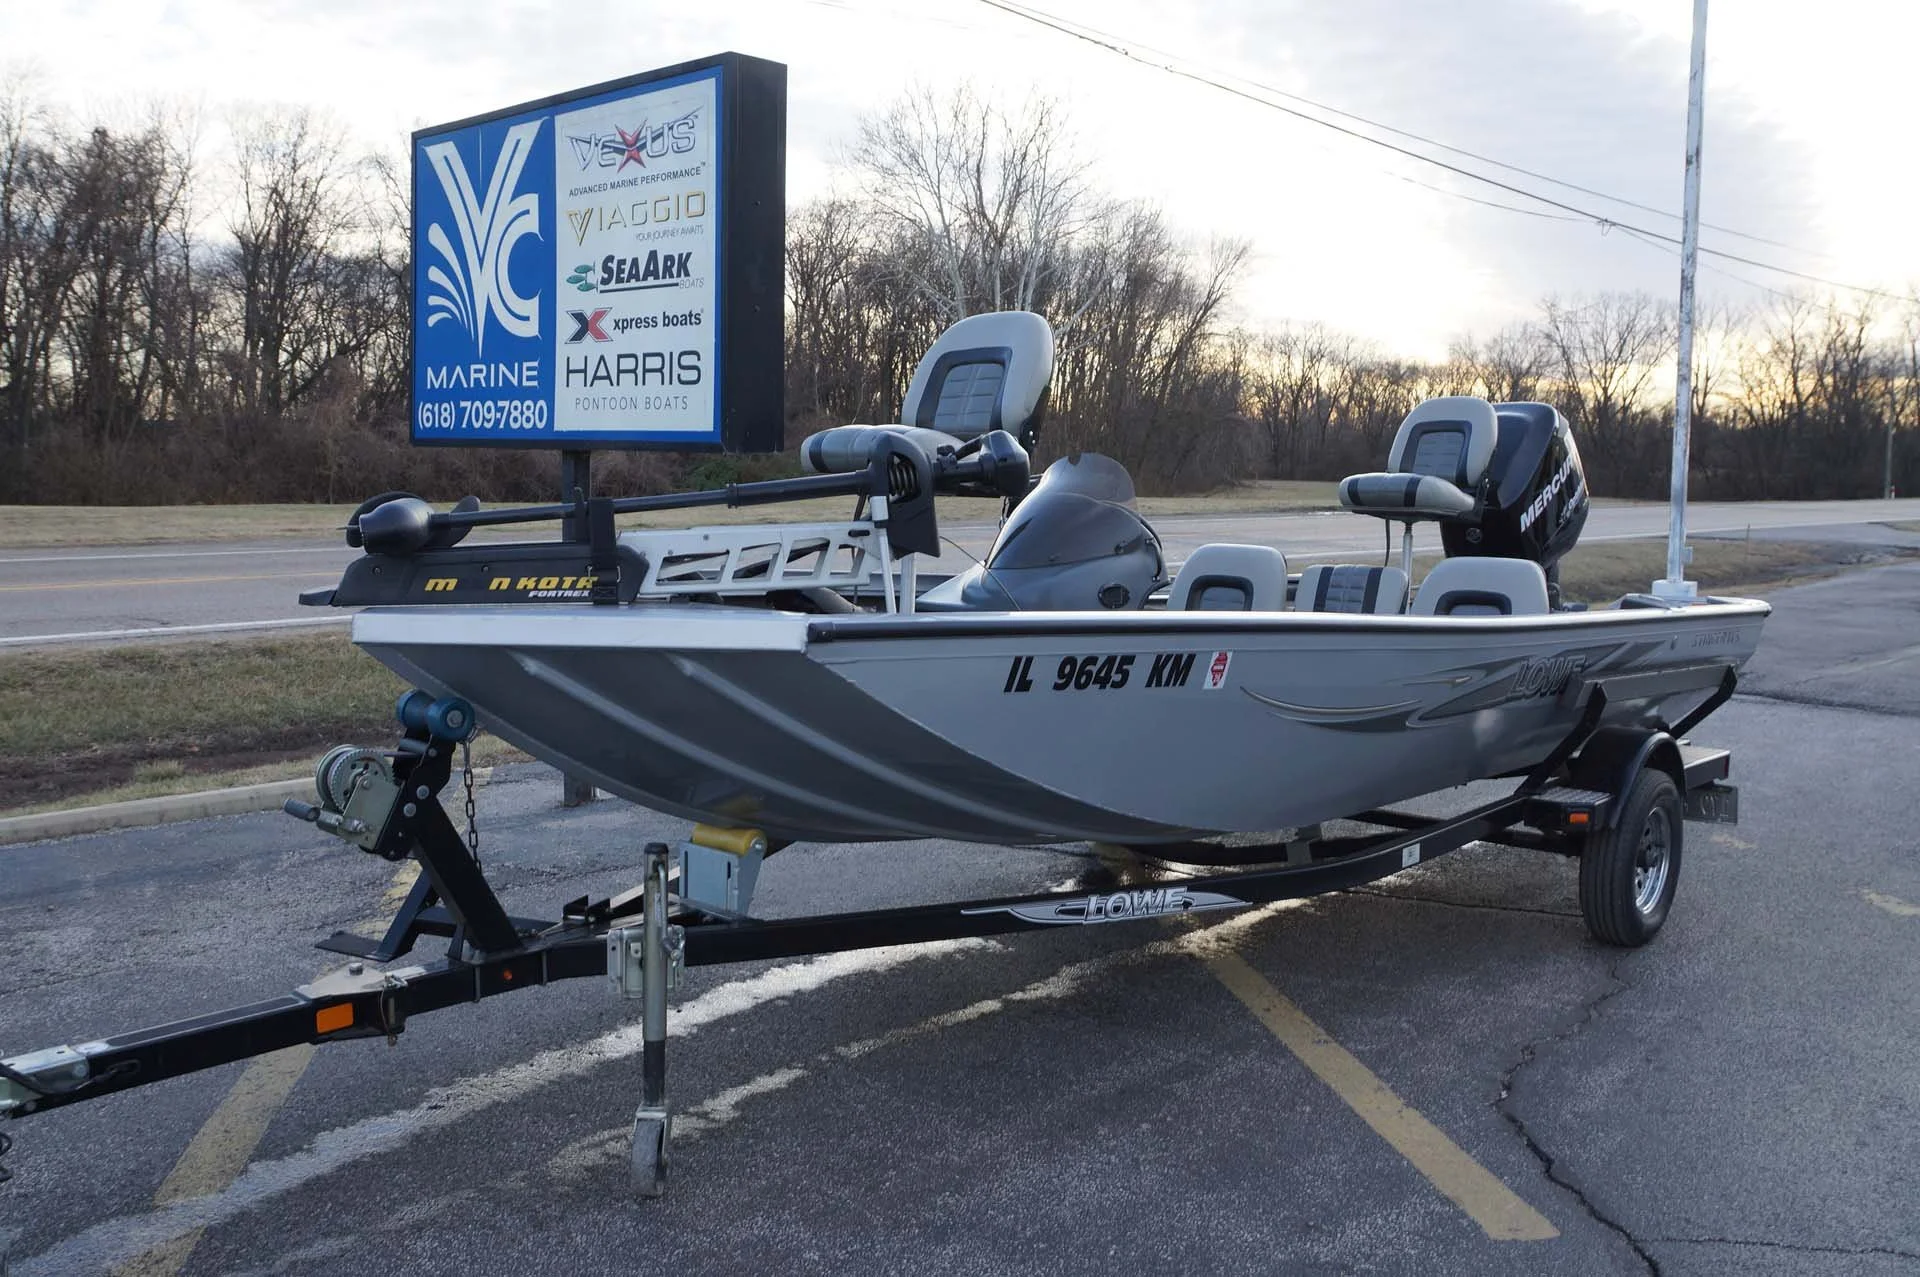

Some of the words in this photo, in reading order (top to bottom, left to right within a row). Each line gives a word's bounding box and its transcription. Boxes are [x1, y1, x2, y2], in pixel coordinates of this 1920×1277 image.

[566, 117, 698, 173] VEXUS
[568, 183, 608, 197] ADVANCED
[609, 176, 639, 190] MARINE
[640, 165, 702, 185] PERFORMANCE
[567, 191, 706, 246] VIAGGIO
[680, 278, 704, 289] BOATS
[613, 315, 658, 334] xpress
[663, 310, 702, 327] boats
[427, 360, 539, 390] MARINE
[566, 350, 701, 388] HARRIS
[418, 401, 456, 430] (618)
[459, 400, 548, 430] 709-7880
[575, 396, 637, 410] PONTOON
[645, 396, 688, 410] BOATS
[1520, 453, 1574, 533] MERCUR
[528, 590, 590, 598] FORTREX
[1003, 655, 1034, 693] IL
[1052, 655, 1136, 691] 9645
[1145, 653, 1197, 689] KM
[1083, 886, 1190, 923] LOWE
